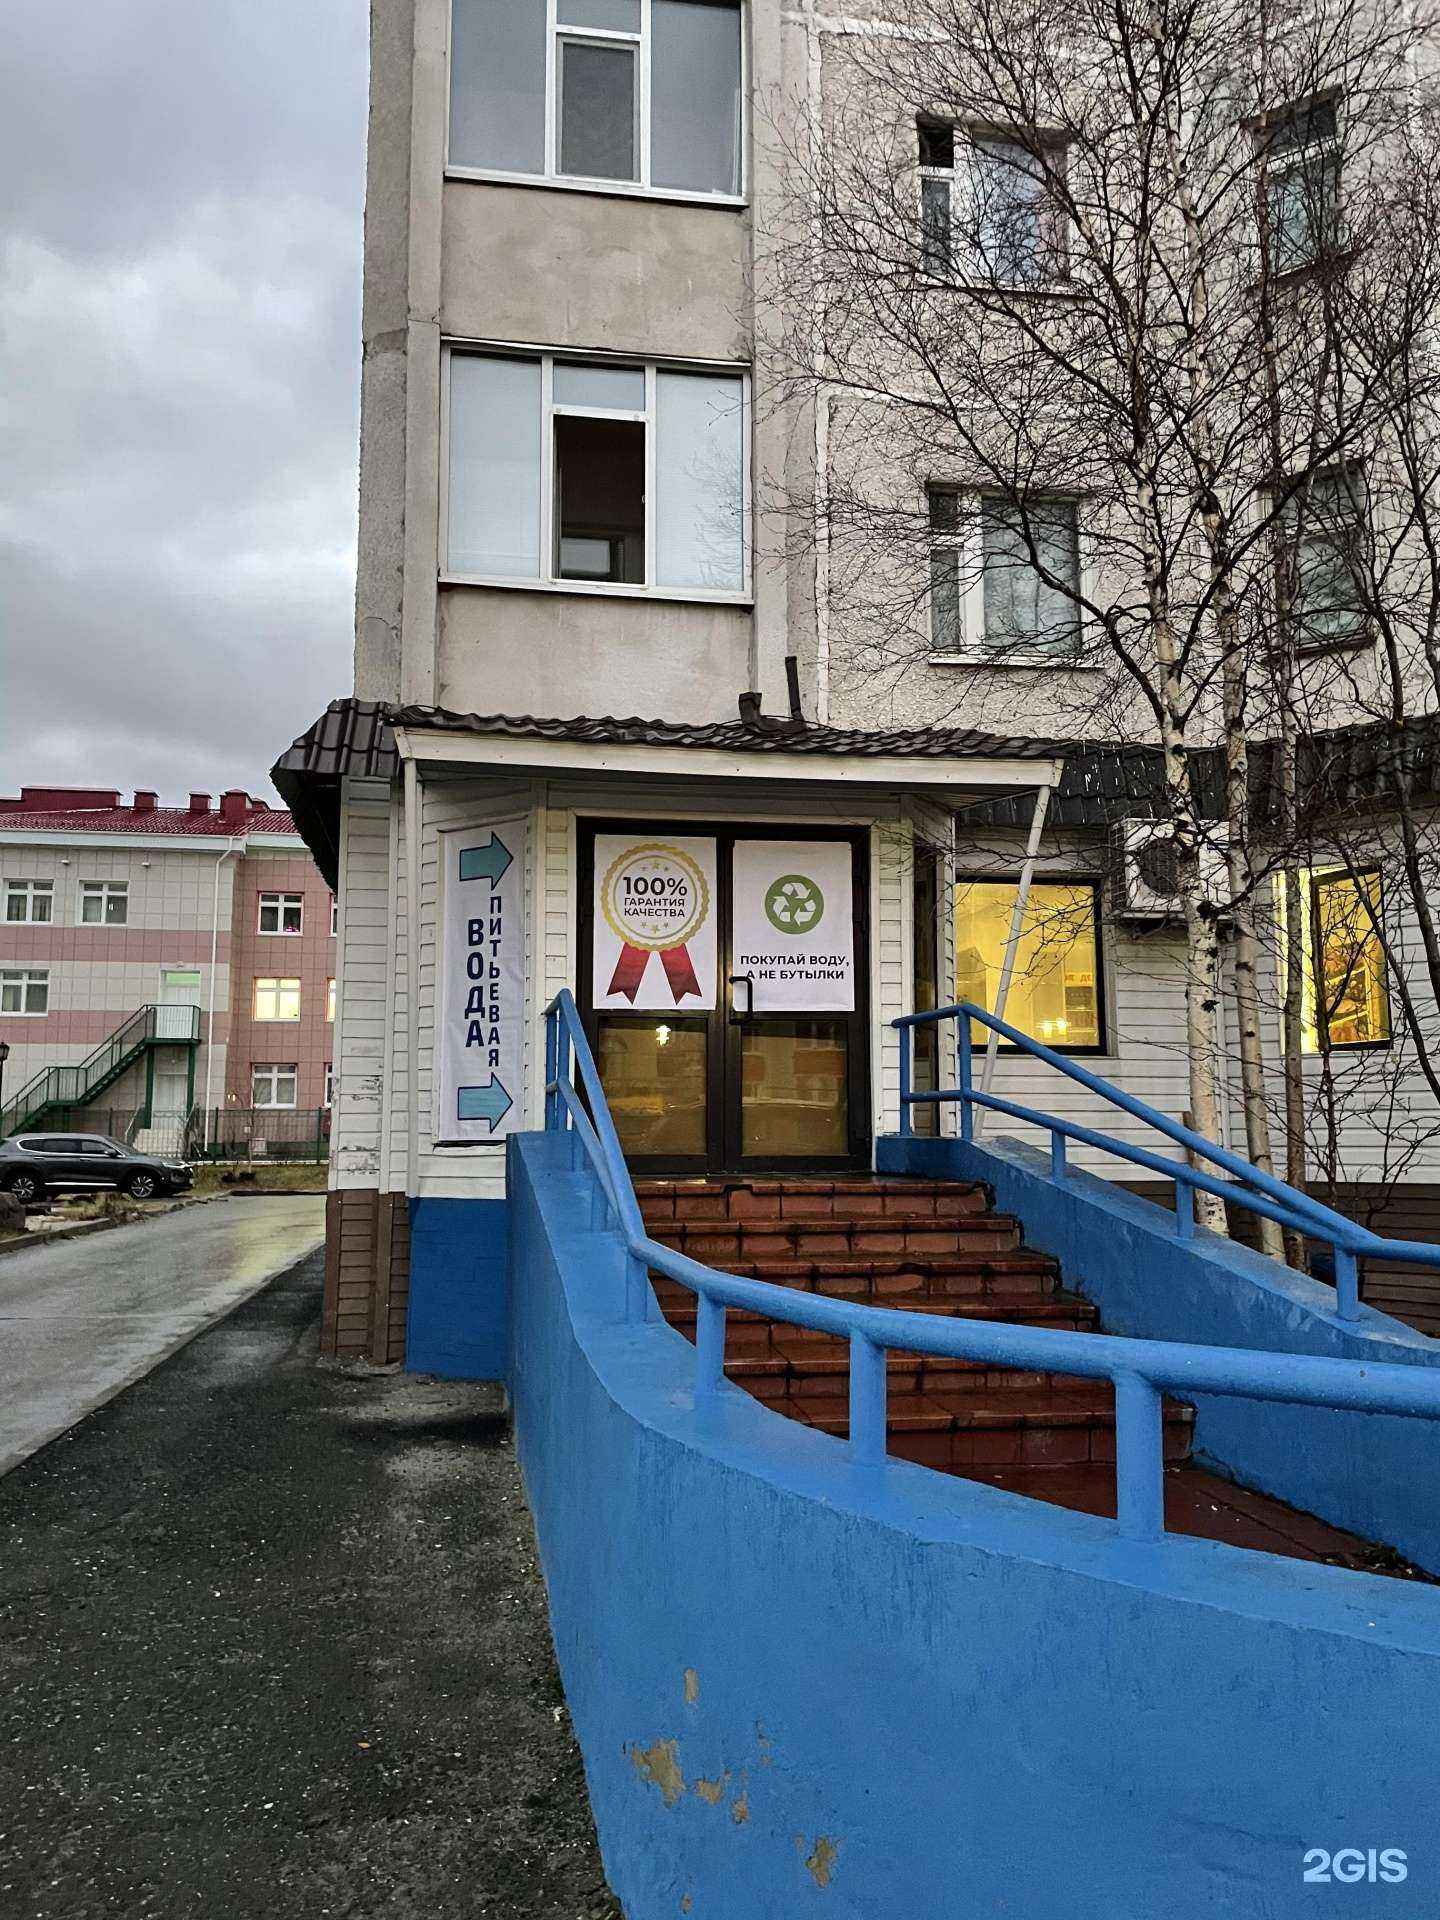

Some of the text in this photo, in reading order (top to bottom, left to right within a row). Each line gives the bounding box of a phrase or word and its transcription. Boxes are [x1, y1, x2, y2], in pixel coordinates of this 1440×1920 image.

[623, 876, 688, 896] 100%
[624, 897, 685, 907] ГАРАНТИЯ
[624, 908, 685, 917] КАЧЕСТВА
[740, 954, 850, 967] ПОКУПАЙ ВОДУ,
[488, 895, 502, 1067] ПИТЬЕВАЯ
[746, 970, 845, 979] А НЕ БУТЫЛКИ
[464, 918, 485, 1048] ВОДА
